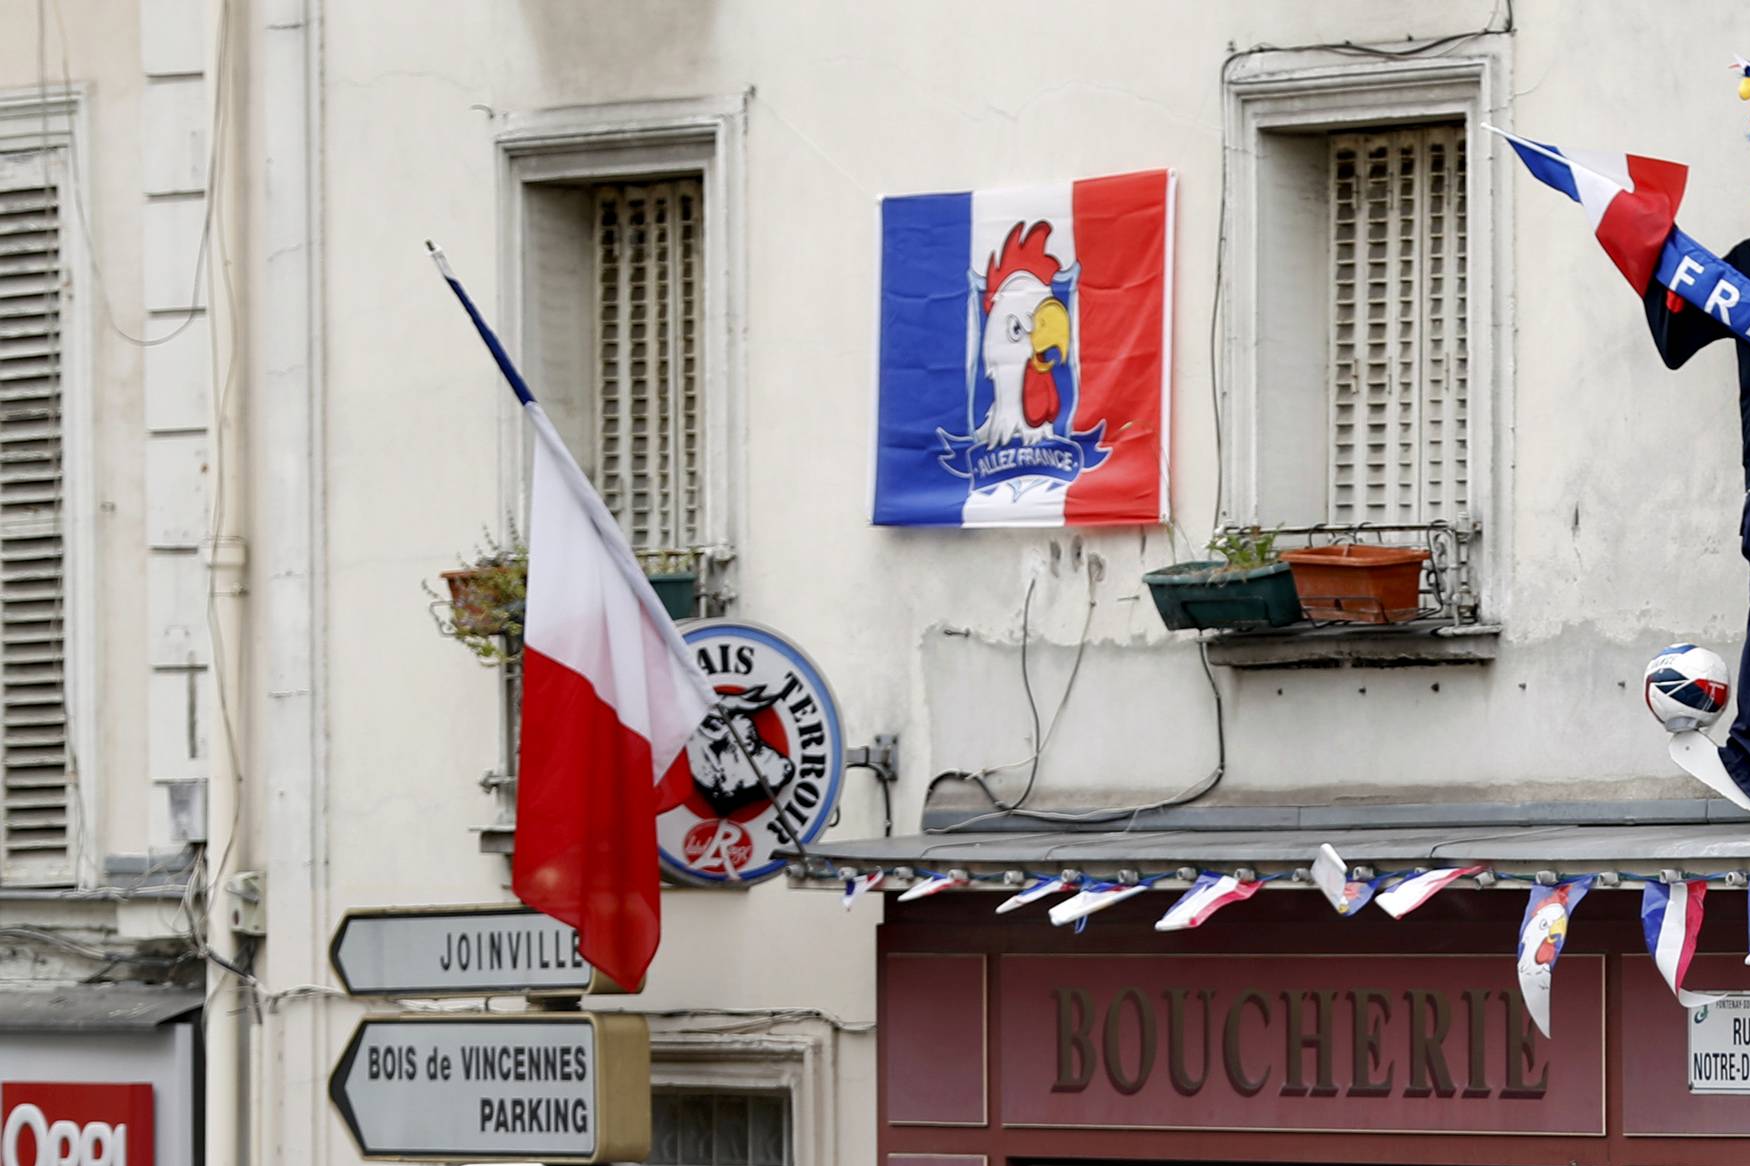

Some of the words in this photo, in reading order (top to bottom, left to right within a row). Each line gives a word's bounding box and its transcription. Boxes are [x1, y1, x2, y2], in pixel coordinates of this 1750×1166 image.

[977, 449, 1017, 475] ALLEZ
[1016, 447, 1075, 473] FRANCE
[766, 670, 827, 845] TERROIR
[440, 931, 583, 971] JOINVILLE
[1050, 986, 1551, 1100] BOUCHERIE
[368, 1046, 417, 1080] BOIS
[427, 1047, 451, 1080] de
[461, 1046, 587, 1081] VINCENNES
[480, 1098, 588, 1133] PARKING
